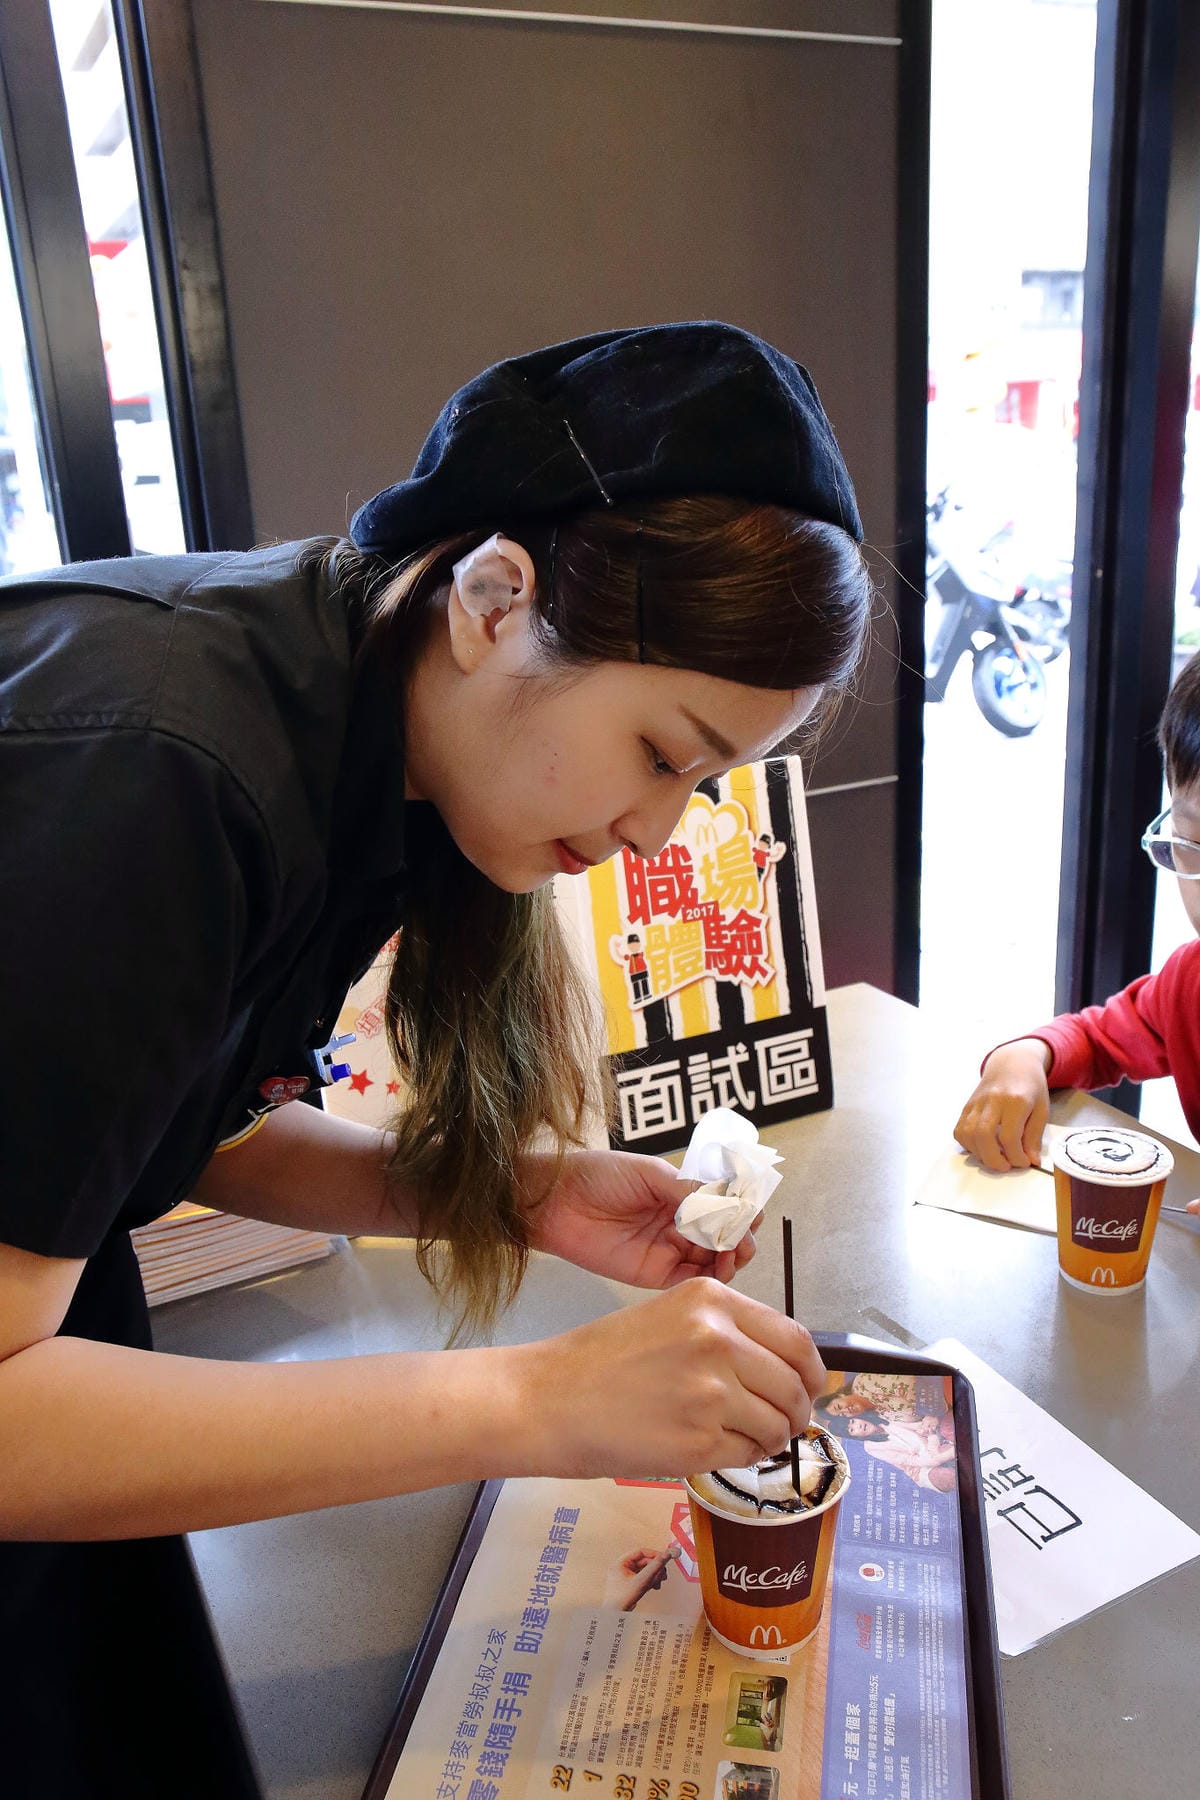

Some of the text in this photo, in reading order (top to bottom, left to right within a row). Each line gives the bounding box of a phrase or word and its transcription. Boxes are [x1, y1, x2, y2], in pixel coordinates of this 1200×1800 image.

[686, 904, 716, 920] 2017
[617, 1027, 819, 1142] 面試區
[1075, 1216, 1138, 1241] McCafé
[722, 1560, 808, 1592] McCafé
[465, 1506, 581, 1800] 零錢隨手捐 助遠地就醫病童
[436, 1628, 508, 1800] 支持麥當勞叔叔之家
[551, 1764, 573, 1793] 22
